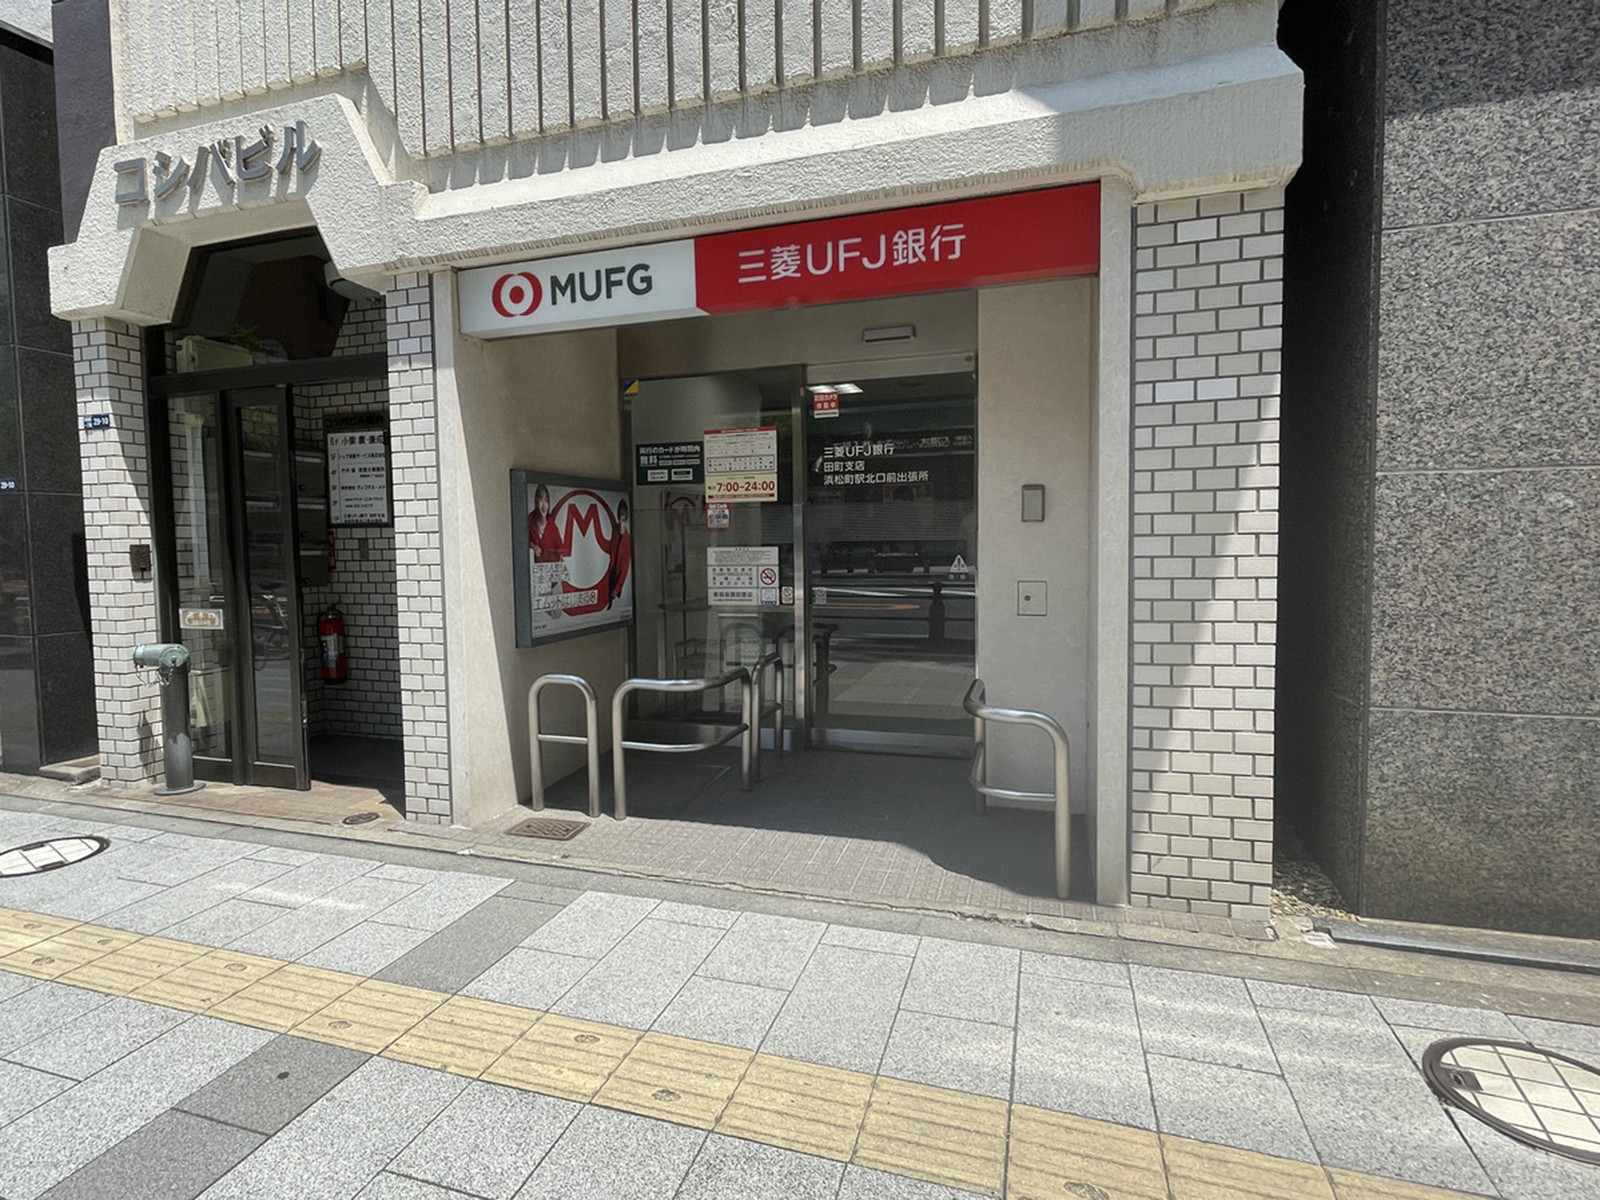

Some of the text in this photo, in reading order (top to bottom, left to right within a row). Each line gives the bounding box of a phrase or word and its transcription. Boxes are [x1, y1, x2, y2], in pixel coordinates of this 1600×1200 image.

[738, 223, 966, 284] 三菱UFJ銀行
[550, 263, 653, 306] MUFG
[93, 417, 109, 426] 29-10
[823, 443, 894, 458] 三菱UFJ銀行
[823, 460, 865, 472] 田町支店
[823, 470, 929, 485] 浜松町駅北口前出張所
[716, 480, 776, 493] 7:00-24:00
